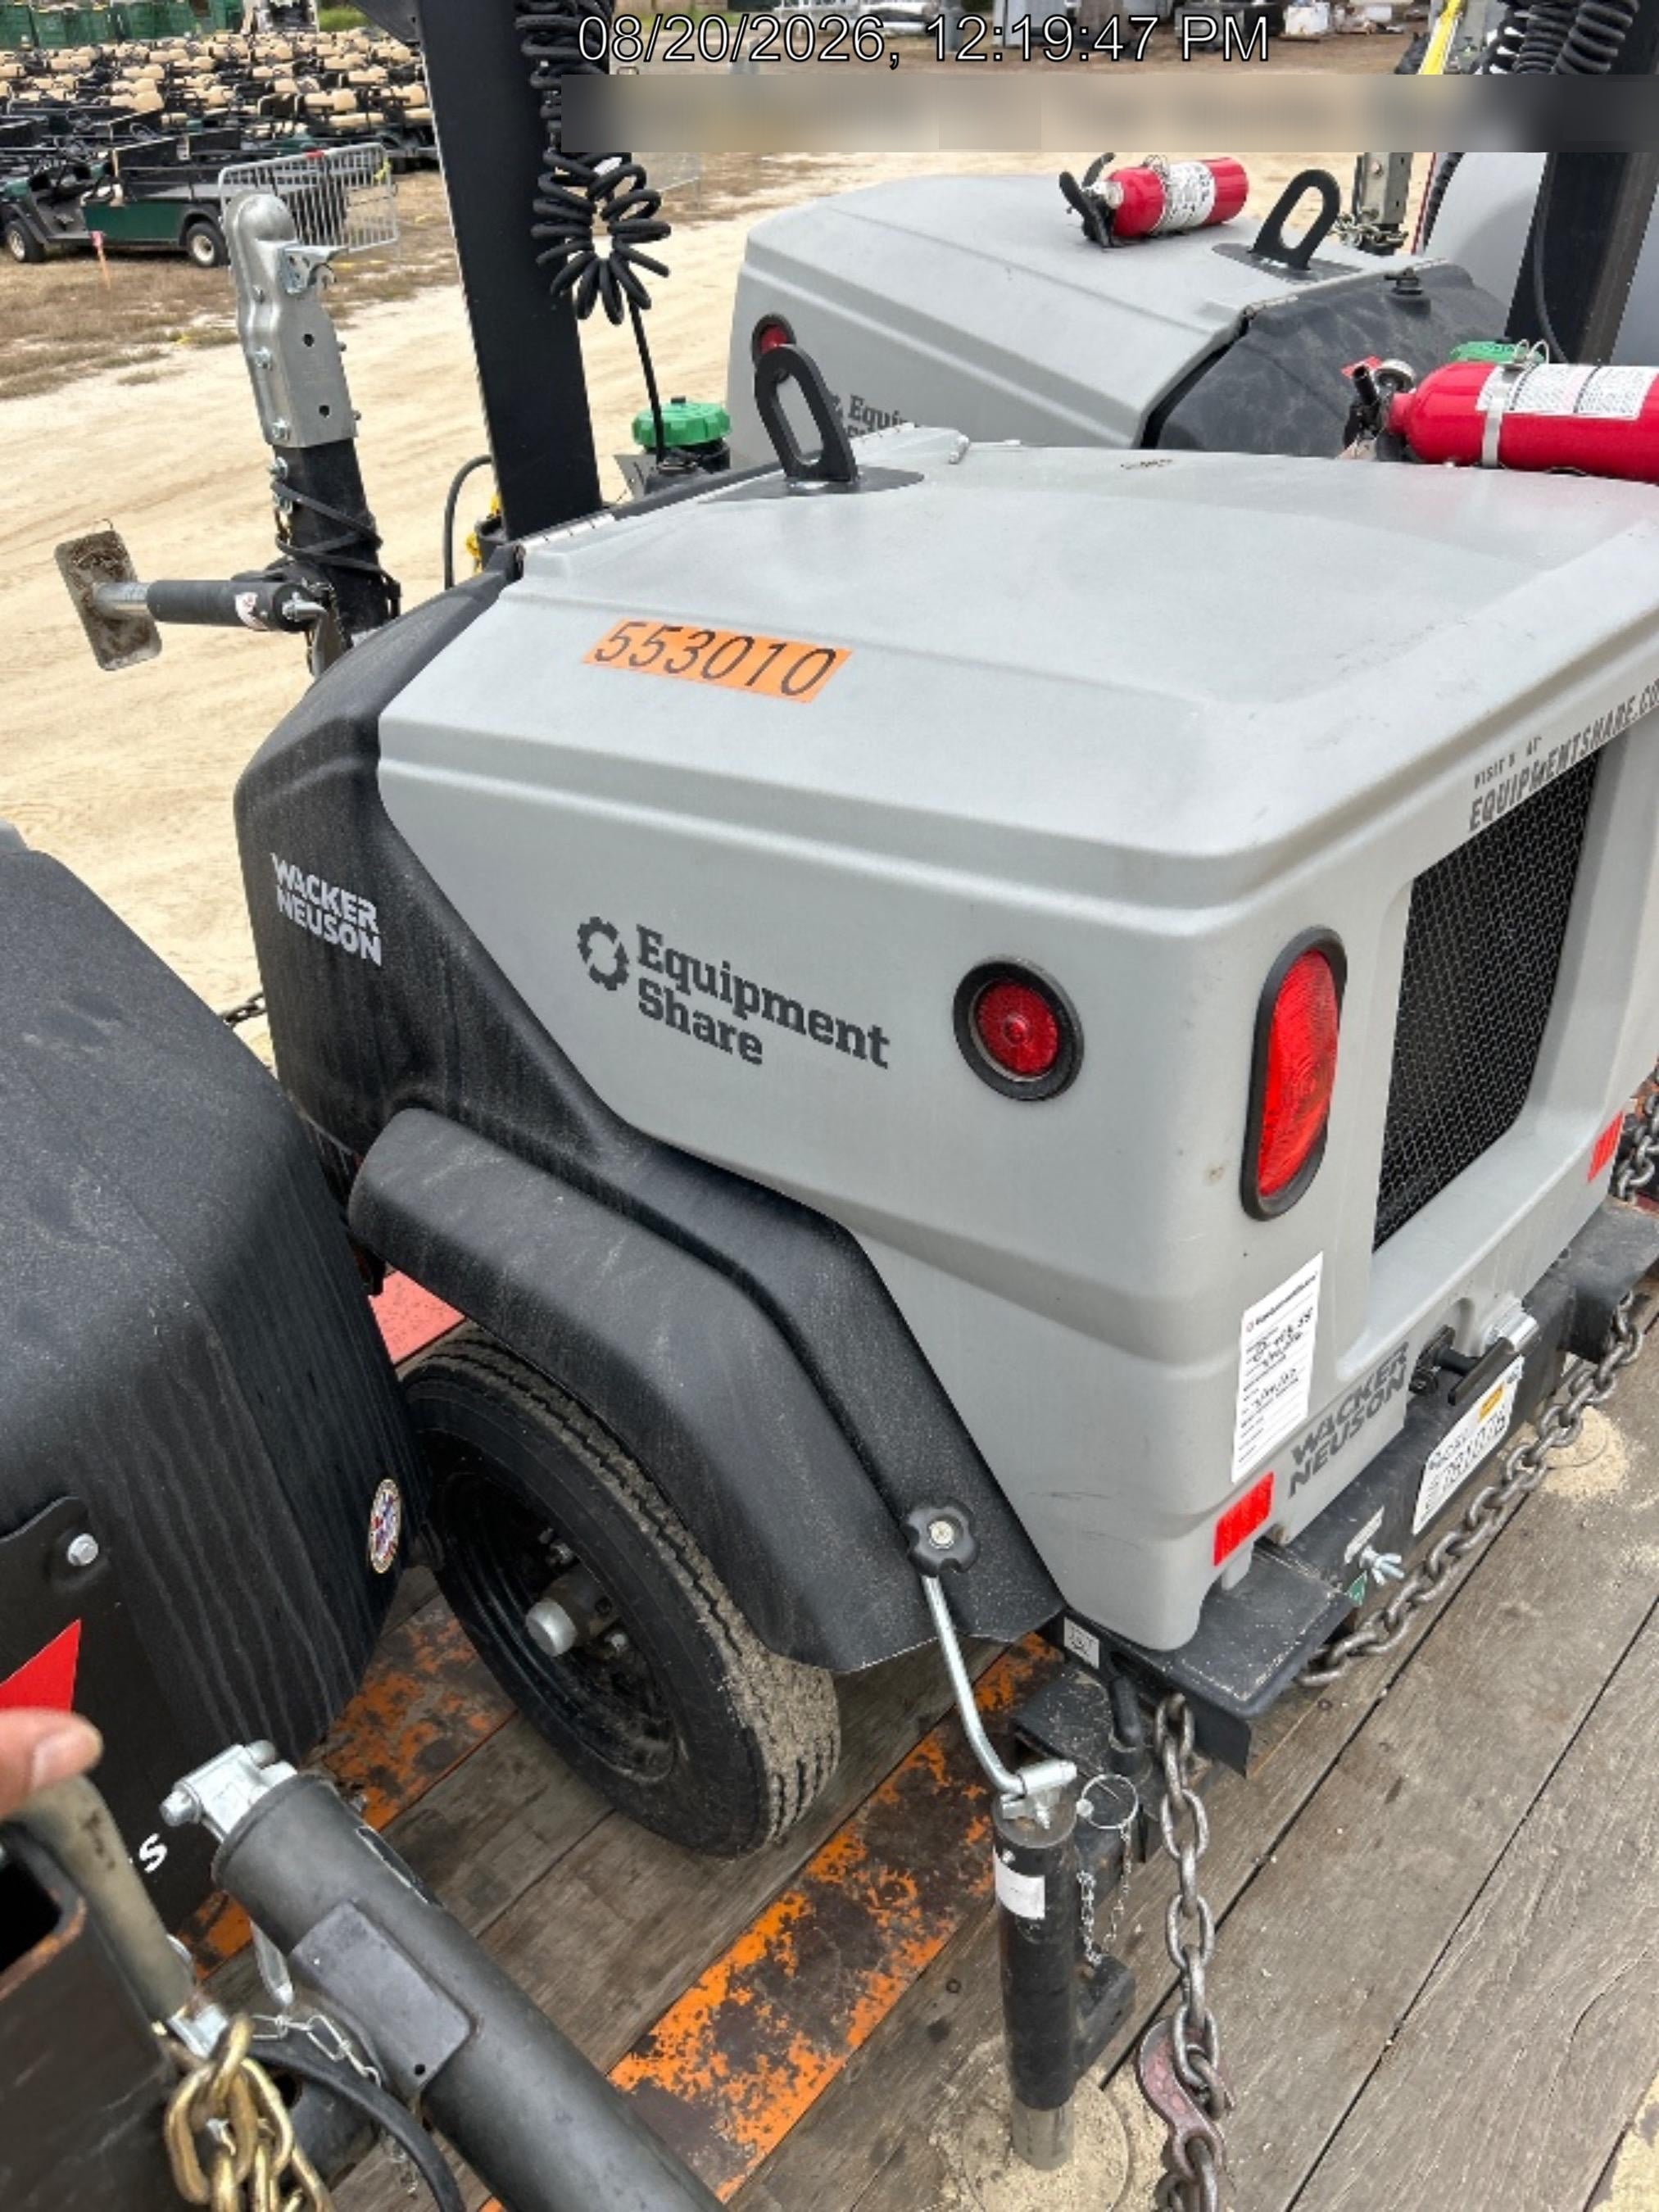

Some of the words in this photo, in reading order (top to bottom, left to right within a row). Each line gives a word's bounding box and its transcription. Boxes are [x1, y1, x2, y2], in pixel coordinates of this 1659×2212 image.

[848, 394, 908, 432] Equi
[594, 621, 836, 696] 553010
[270, 852, 380, 934] WACKER
[277, 884, 383, 966] NEUSON
[636, 924, 890, 1068] Equipment
[638, 977, 763, 1065] Share
[1289, 1364, 1407, 1498] NEUSON
[1290, 1341, 1409, 1465] WACKER
